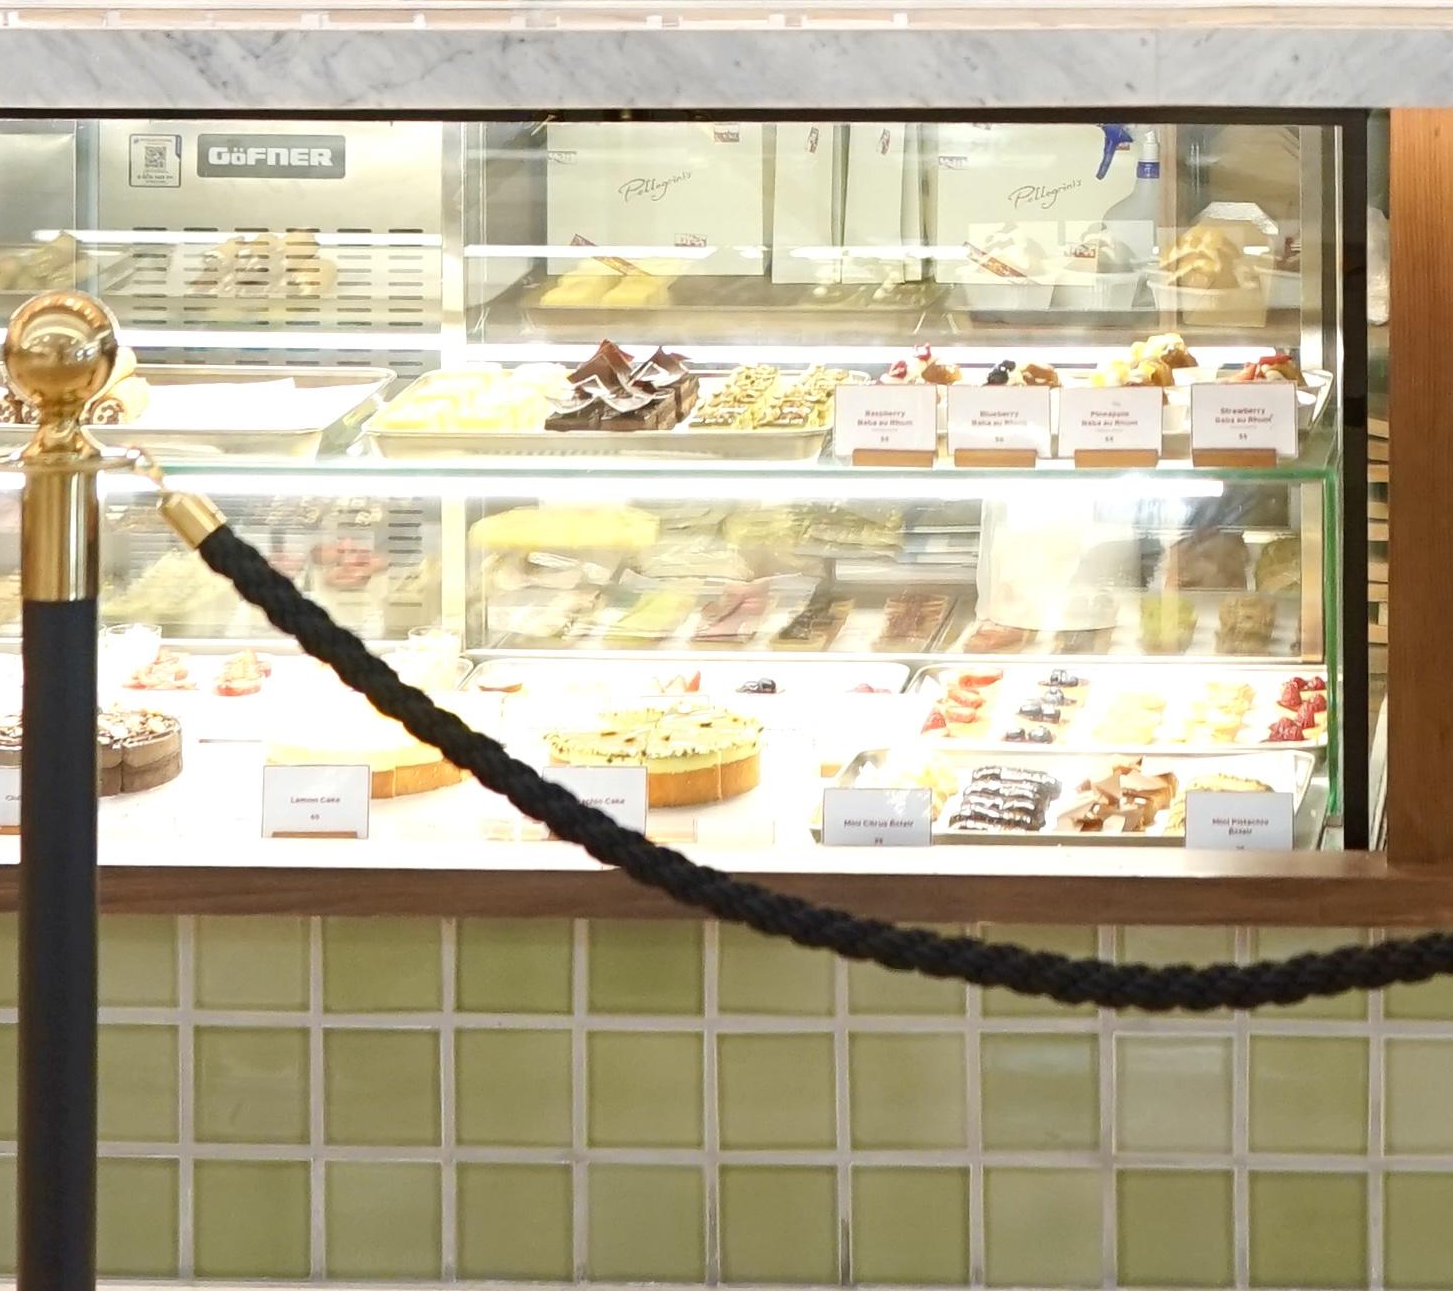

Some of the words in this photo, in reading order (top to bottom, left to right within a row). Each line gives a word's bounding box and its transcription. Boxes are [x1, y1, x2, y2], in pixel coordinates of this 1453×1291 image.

[864, 409, 906, 418] Raspberry
[979, 410, 1019, 418] Blueberry
[1090, 410, 1130, 419] Pineapple
[1220, 407, 1266, 416] Strawberry
[290, 796, 319, 804] Lemon
[319, 796, 341, 804] Cake
